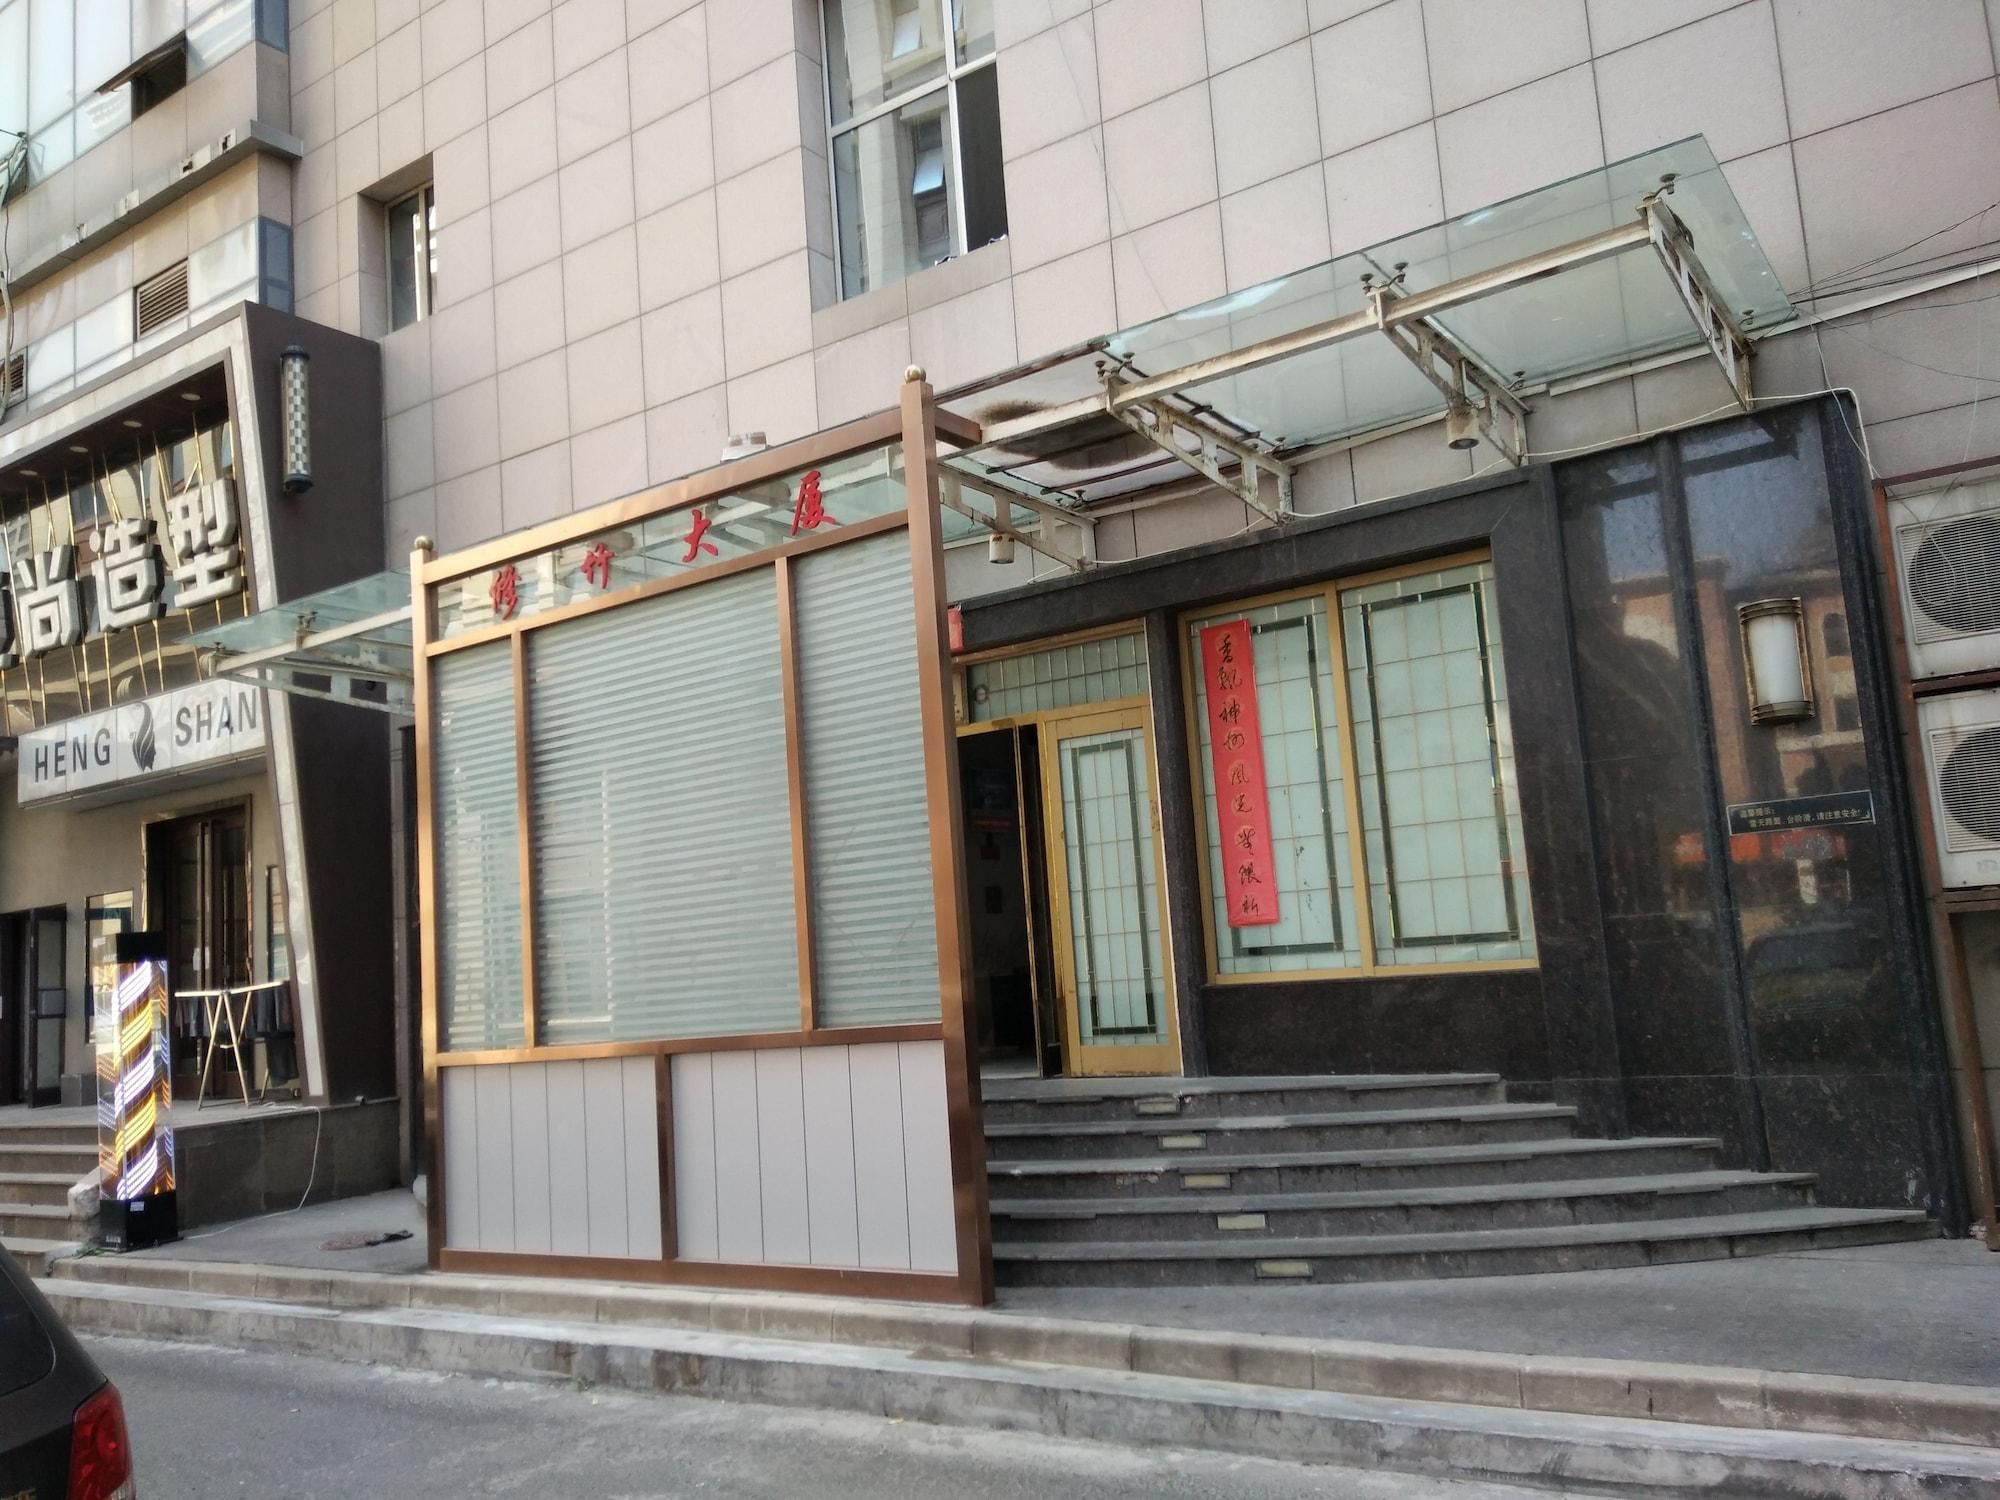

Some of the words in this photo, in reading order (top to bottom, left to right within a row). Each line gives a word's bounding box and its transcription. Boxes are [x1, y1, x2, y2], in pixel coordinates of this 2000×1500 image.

[0, 477, 245, 669] 尚造型
[34, 728, 111, 781] HENG
[174, 688, 258, 747] SHAN
